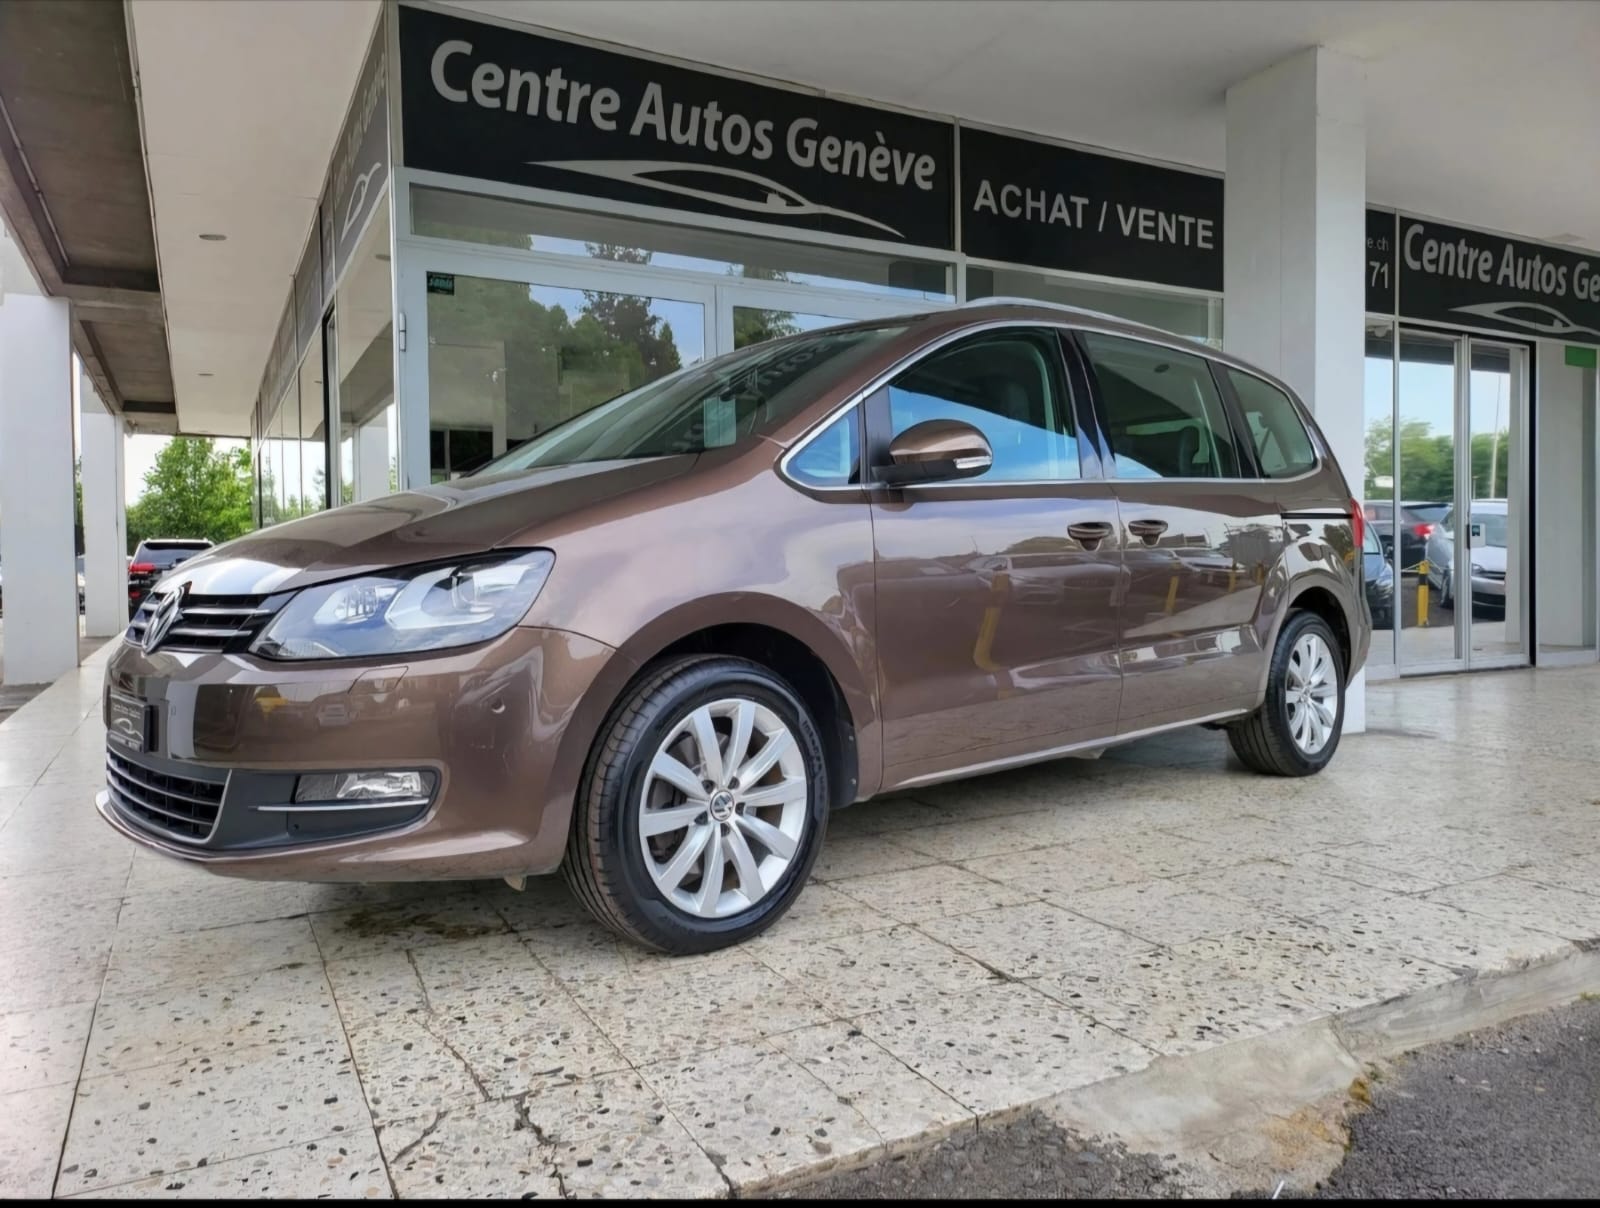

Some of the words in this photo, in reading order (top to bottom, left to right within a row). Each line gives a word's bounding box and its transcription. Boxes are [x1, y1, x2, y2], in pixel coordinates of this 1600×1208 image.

[430, 40, 620, 131] Centre
[630, 82, 773, 160] Autos
[786, 118, 936, 190] Genève
[973, 179, 1089, 229] ACHAT
[1098, 201, 1108, 233] /
[1116, 203, 1214, 250] VENTE
[1369, 260, 1389, 289] 71
[1404, 223, 1493, 283] Centre
[1496, 243, 1568, 297] Autos
